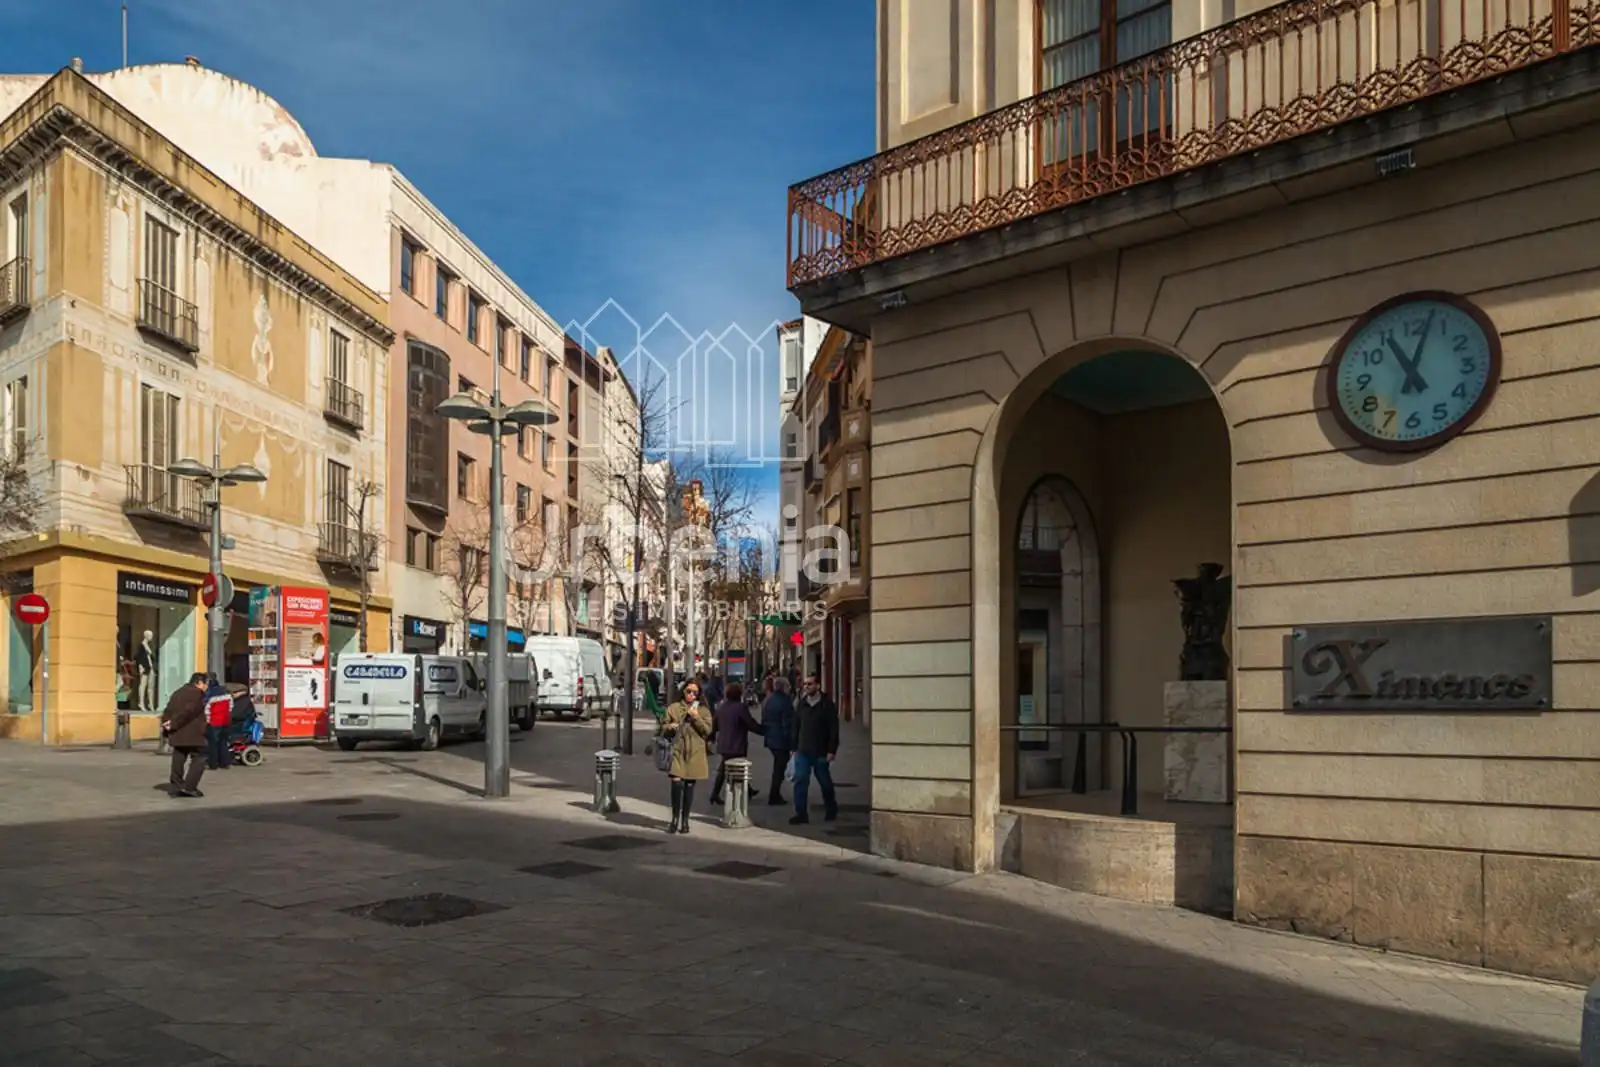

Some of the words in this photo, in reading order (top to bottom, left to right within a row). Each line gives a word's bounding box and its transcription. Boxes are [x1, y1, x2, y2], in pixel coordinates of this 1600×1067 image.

[1403, 319, 1425, 337] 12
[1440, 319, 1447, 335] 1
[1453, 335, 1468, 351] 2
[1363, 349, 1383, 366] 10
[1459, 357, 1475, 375] 3
[1357, 374, 1372, 391] 9
[1451, 383, 1467, 400] 4
[1362, 396, 1378, 412] 8
[1432, 403, 1448, 420] 5
[1383, 410, 1396, 428] 7
[1405, 411, 1421, 429] 6
